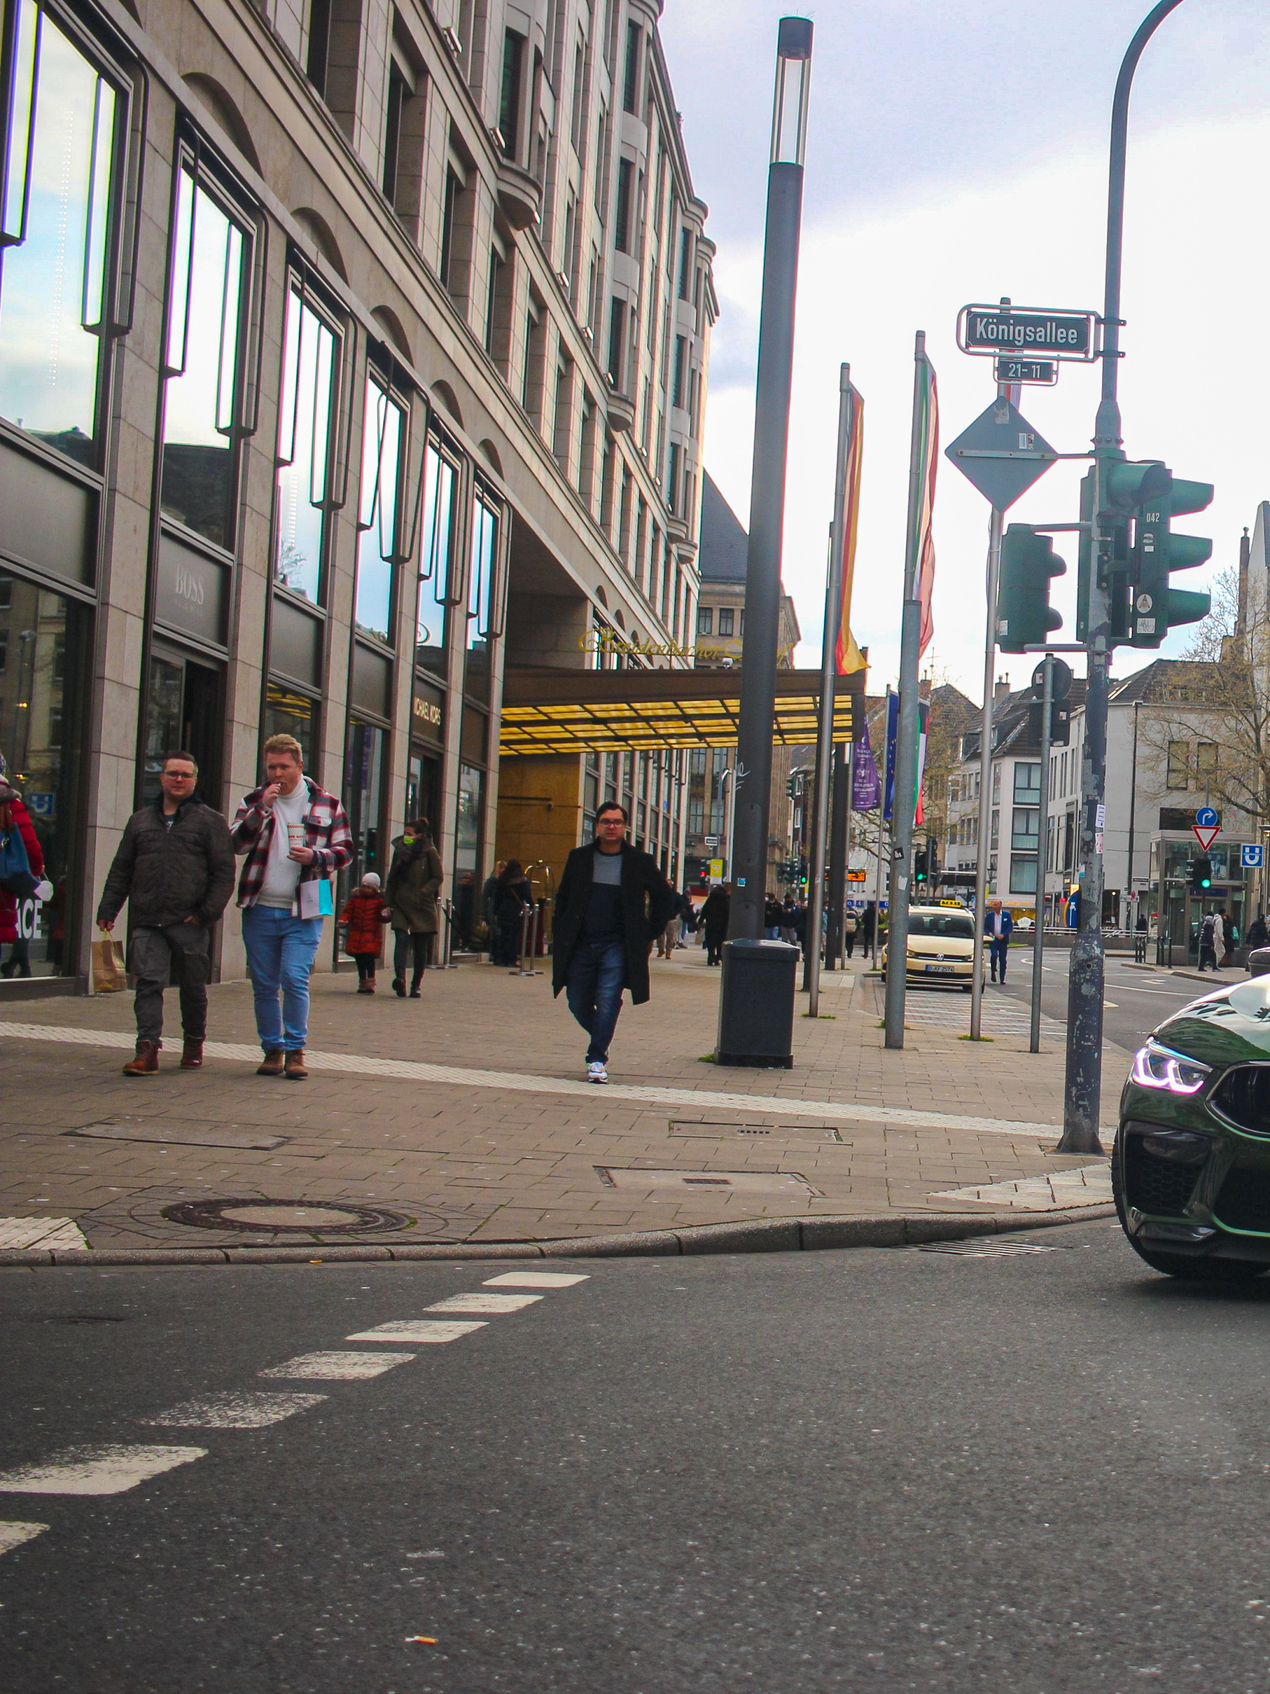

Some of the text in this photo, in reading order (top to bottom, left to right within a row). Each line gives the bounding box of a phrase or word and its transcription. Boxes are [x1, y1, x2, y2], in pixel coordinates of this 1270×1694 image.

[976, 318, 1078, 346] Königsallee
[1146, 512, 1160, 523] 042
[176, 564, 204, 605] BOSS
